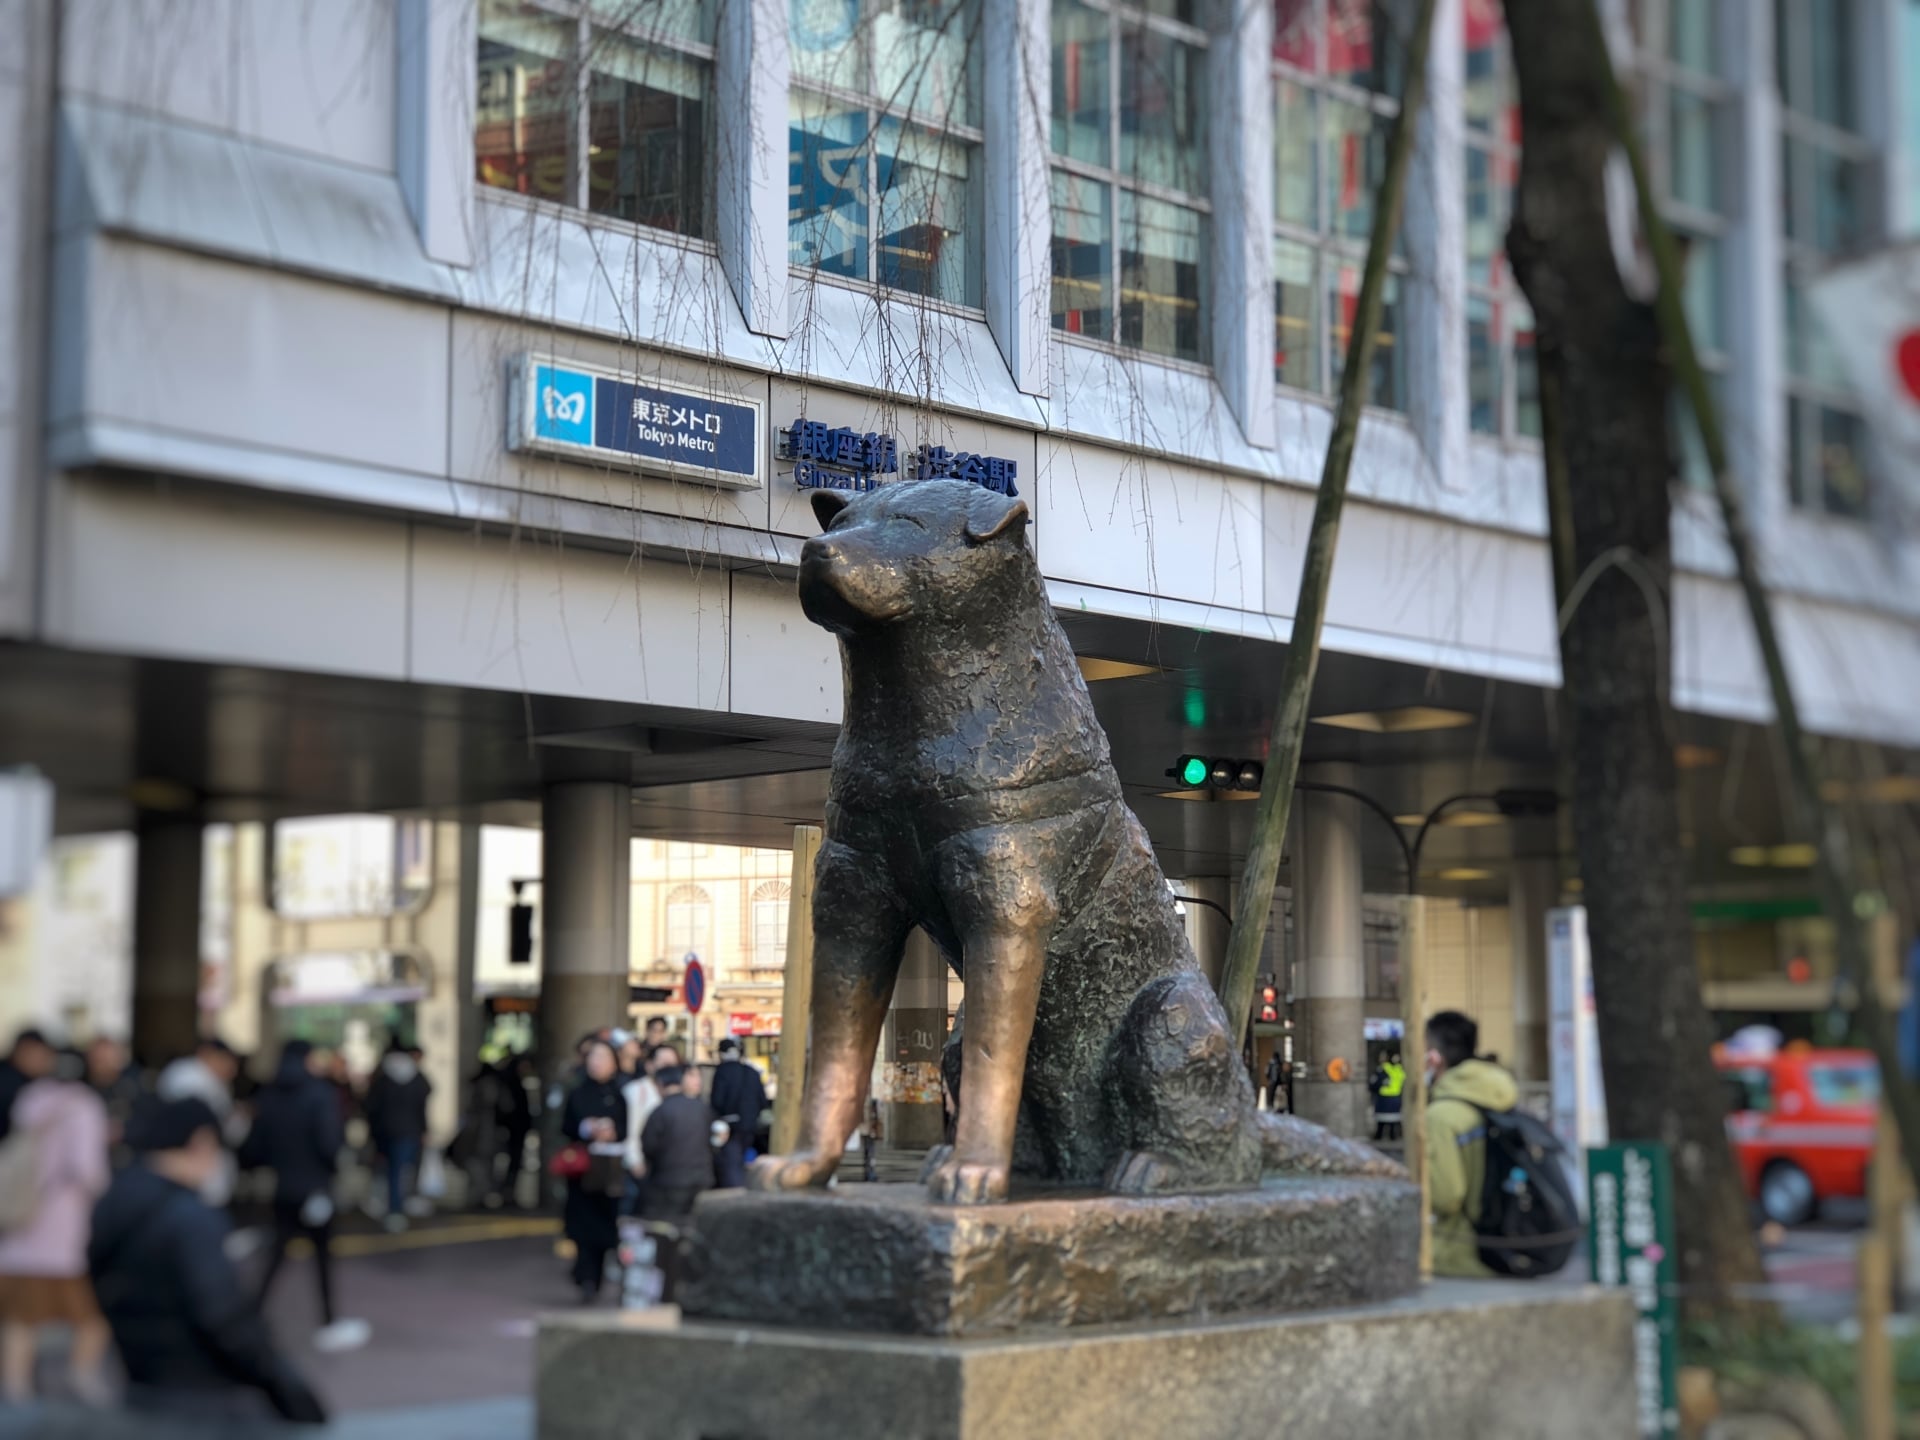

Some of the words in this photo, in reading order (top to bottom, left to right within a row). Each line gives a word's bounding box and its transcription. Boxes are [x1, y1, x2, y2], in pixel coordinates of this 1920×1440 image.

[632, 398, 720, 434] 東京メトロ
[637, 424, 675, 447] Tokyo
[678, 431, 715, 453] Metro
[789, 419, 897, 474] 銀座線
[918, 443, 1019, 497] 渋谷駅
[794, 461, 851, 489] Ginza
